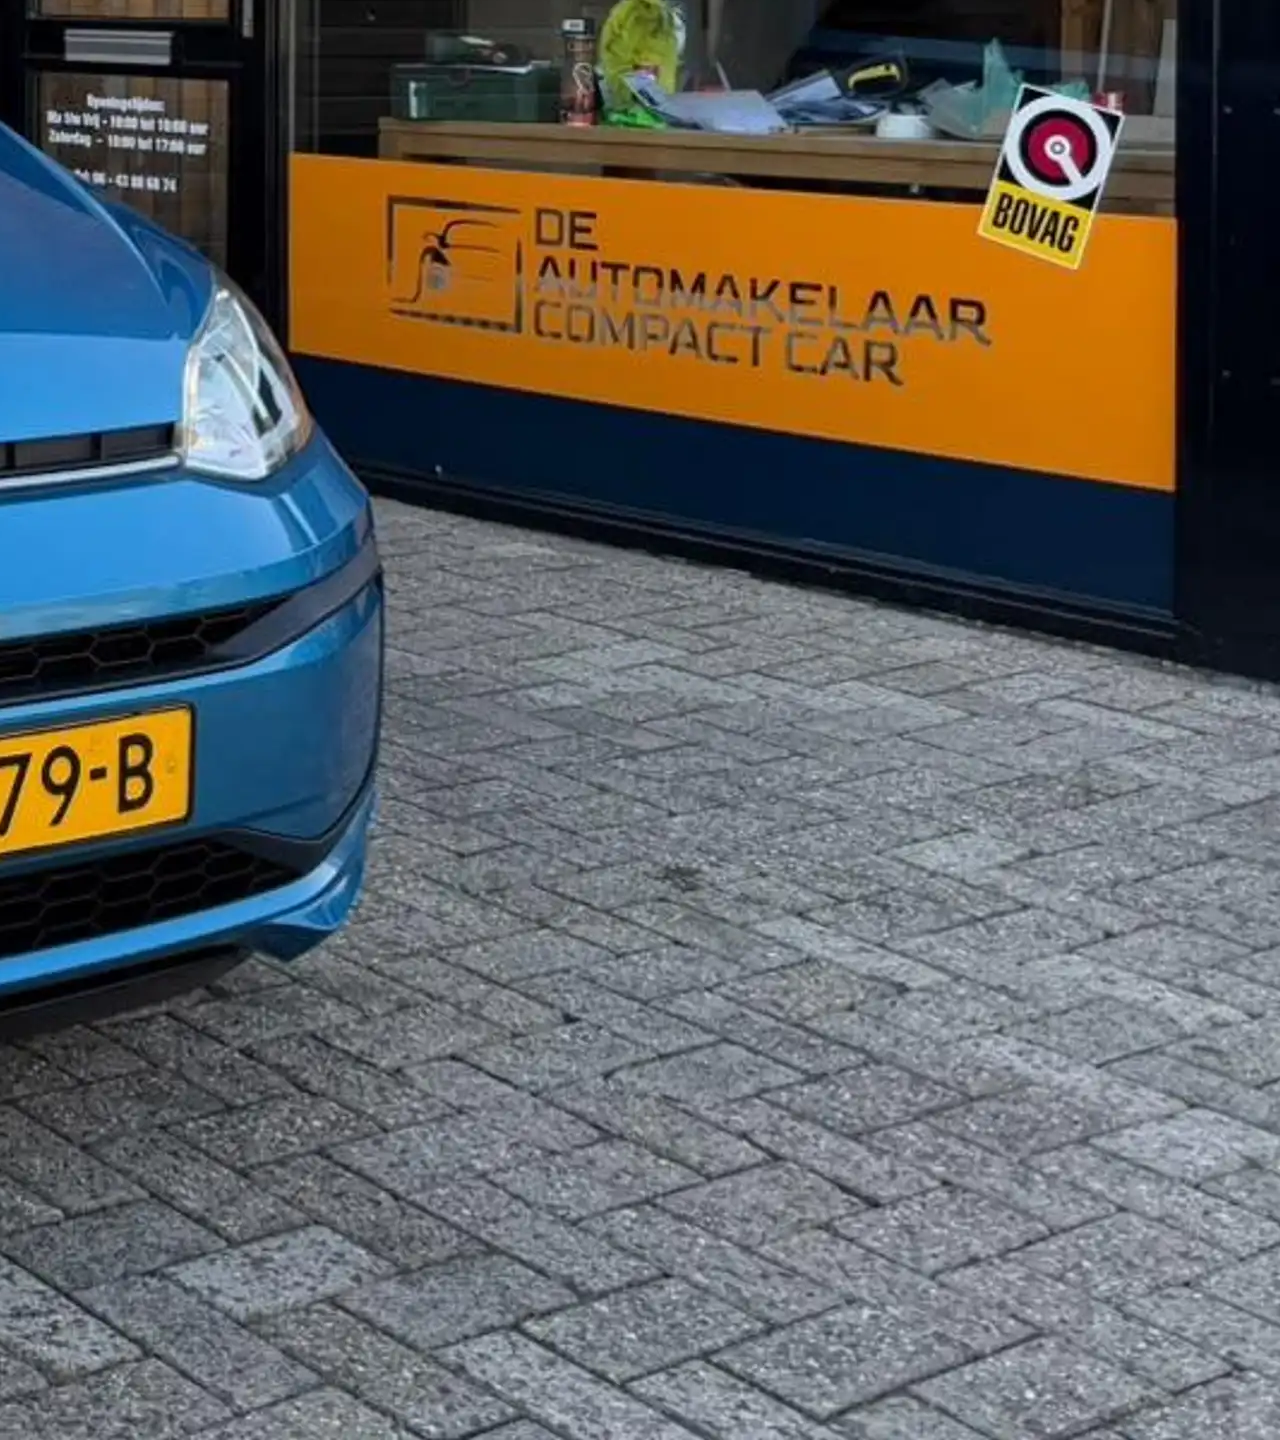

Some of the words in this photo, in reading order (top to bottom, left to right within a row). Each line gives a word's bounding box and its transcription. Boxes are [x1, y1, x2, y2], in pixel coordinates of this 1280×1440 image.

[535, 208, 598, 252] DE
[991, 192, 1080, 253] BOVAG
[534, 254, 992, 347] AUTOMAKELAAR
[533, 300, 773, 369] COMPACT
[785, 332, 905, 387] CAR
